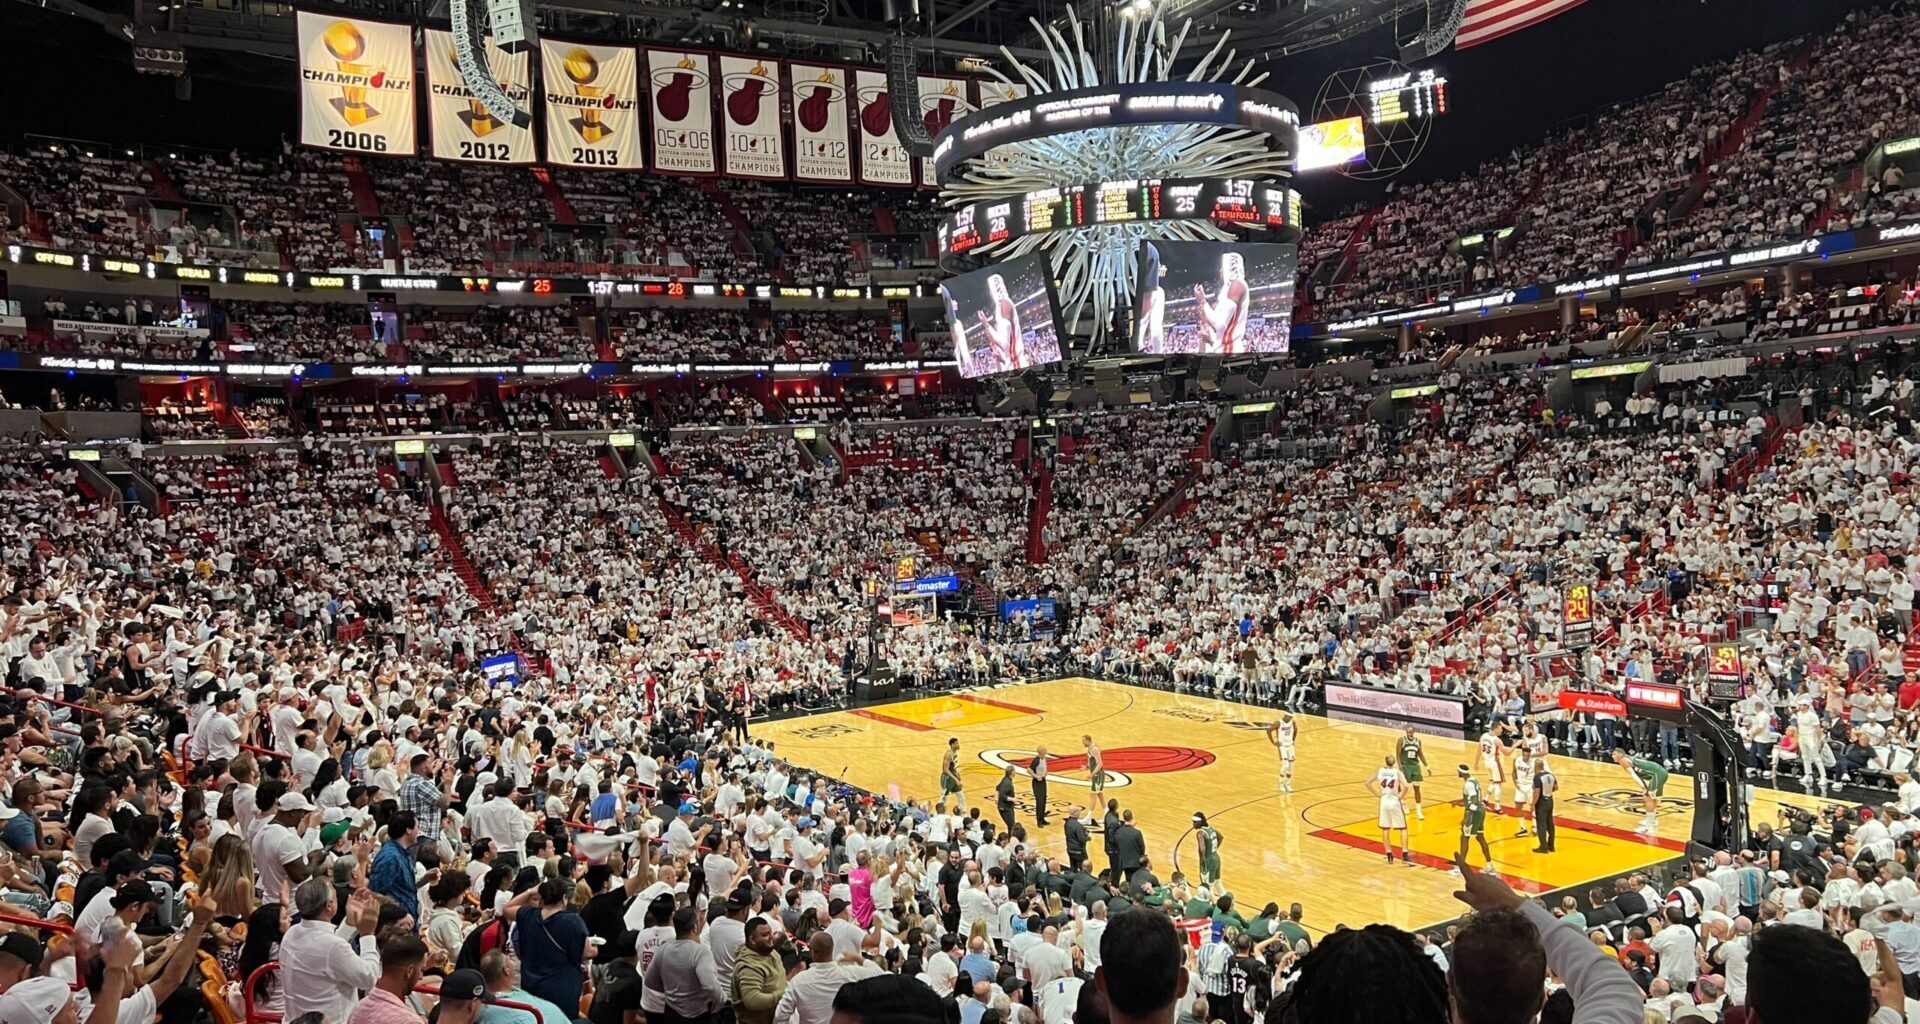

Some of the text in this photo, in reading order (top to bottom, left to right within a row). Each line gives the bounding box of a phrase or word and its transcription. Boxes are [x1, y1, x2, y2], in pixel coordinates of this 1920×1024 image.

[432, 84, 528, 101] CHAMNS!
[1035, 93, 1121, 113] OFFICIAL COMMUNITY
[1081, 107, 1094, 117] OF
[1094, 105, 1111, 117] THE
[328, 129, 387, 152] 2006
[657, 129, 709, 149] 05 06
[731, 134, 778, 154] 10 11
[460, 142, 510, 161] 2012
[801, 139, 845, 158] 11 12
[864, 144, 908, 162] 12 13
[573, 148, 618, 165] 2013
[658, 157, 711, 168] CHAMPIONS
[730, 162, 780, 172] CHAMPIONS
[800, 166, 848, 176] CHAMPIONS
[864, 169, 909, 180] CHAMPIONS
[1170, 183, 1204, 197] HEAT
[1225, 178, 1254, 197] 1:57
[1176, 197, 1195, 212] 25
[1217, 196, 1246, 205] QUARTER
[1219, 210, 1236, 219] TEAM
[1236, 211, 1254, 220] FOULS
[1269, 202, 1280, 216] 28
[955, 205, 976, 227] 1:57
[990, 217, 1006, 233] 28
[176, 267, 211, 279] STEALS
[244, 272, 279, 284] ASSISTS
[310, 276, 344, 287] BLOCKS
[380, 278, 437, 289] HUSTLE STATS
[533, 280, 551, 292] 25
[587, 281, 614, 294] 1:57
[1555, 281, 1585, 295] Florida
[667, 282, 684, 295] 28
[780, 287, 799, 296] TOTAL
[833, 289, 846, 297] OFF
[74, 323, 112, 332] ASSISTANCE?
[112, 326, 127, 334] TEXT
[40, 356, 76, 368] Florida
[898, 565, 912, 578] 24
[917, 581, 950, 591] tmaster
[1568, 600, 1587, 620] 24
[1715, 657, 1732, 670] 24
[1420, 704, 1431, 714] Hot
[1431, 707, 1452, 718] Playoffs
[1586, 699, 1622, 711] State Farm
[1482, 744, 1492, 754] 55
[1380, 778, 1395, 789] 44
[1058, 982, 1064, 994] 1
[1232, 977, 1247, 994] 13
